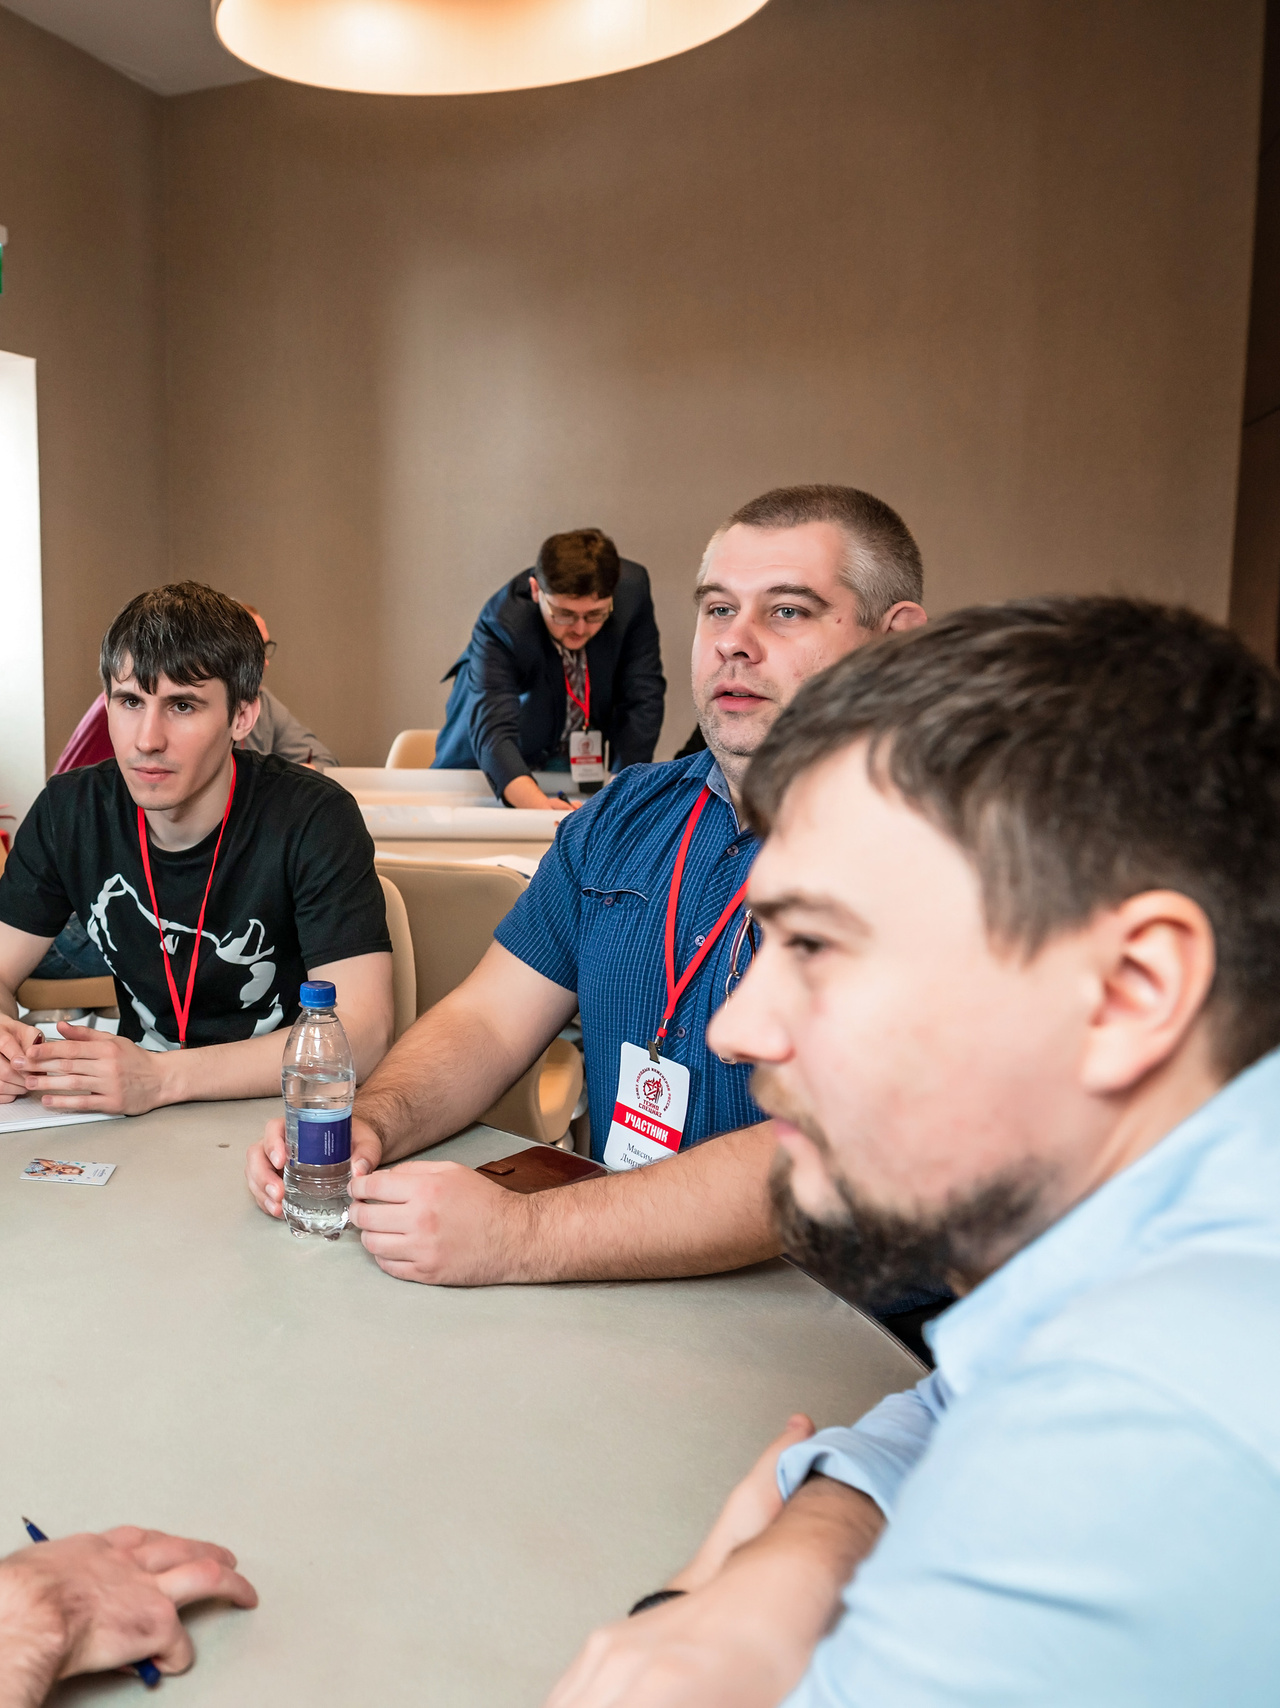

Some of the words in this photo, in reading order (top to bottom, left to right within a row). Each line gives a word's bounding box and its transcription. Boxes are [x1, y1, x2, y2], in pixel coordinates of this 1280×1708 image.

[638, 1103, 662, 1118] СПЕЦНАЗ
[643, 1099, 660, 1111] ТЕХНО
[624, 1111, 669, 1143] УЧАСТНИК
